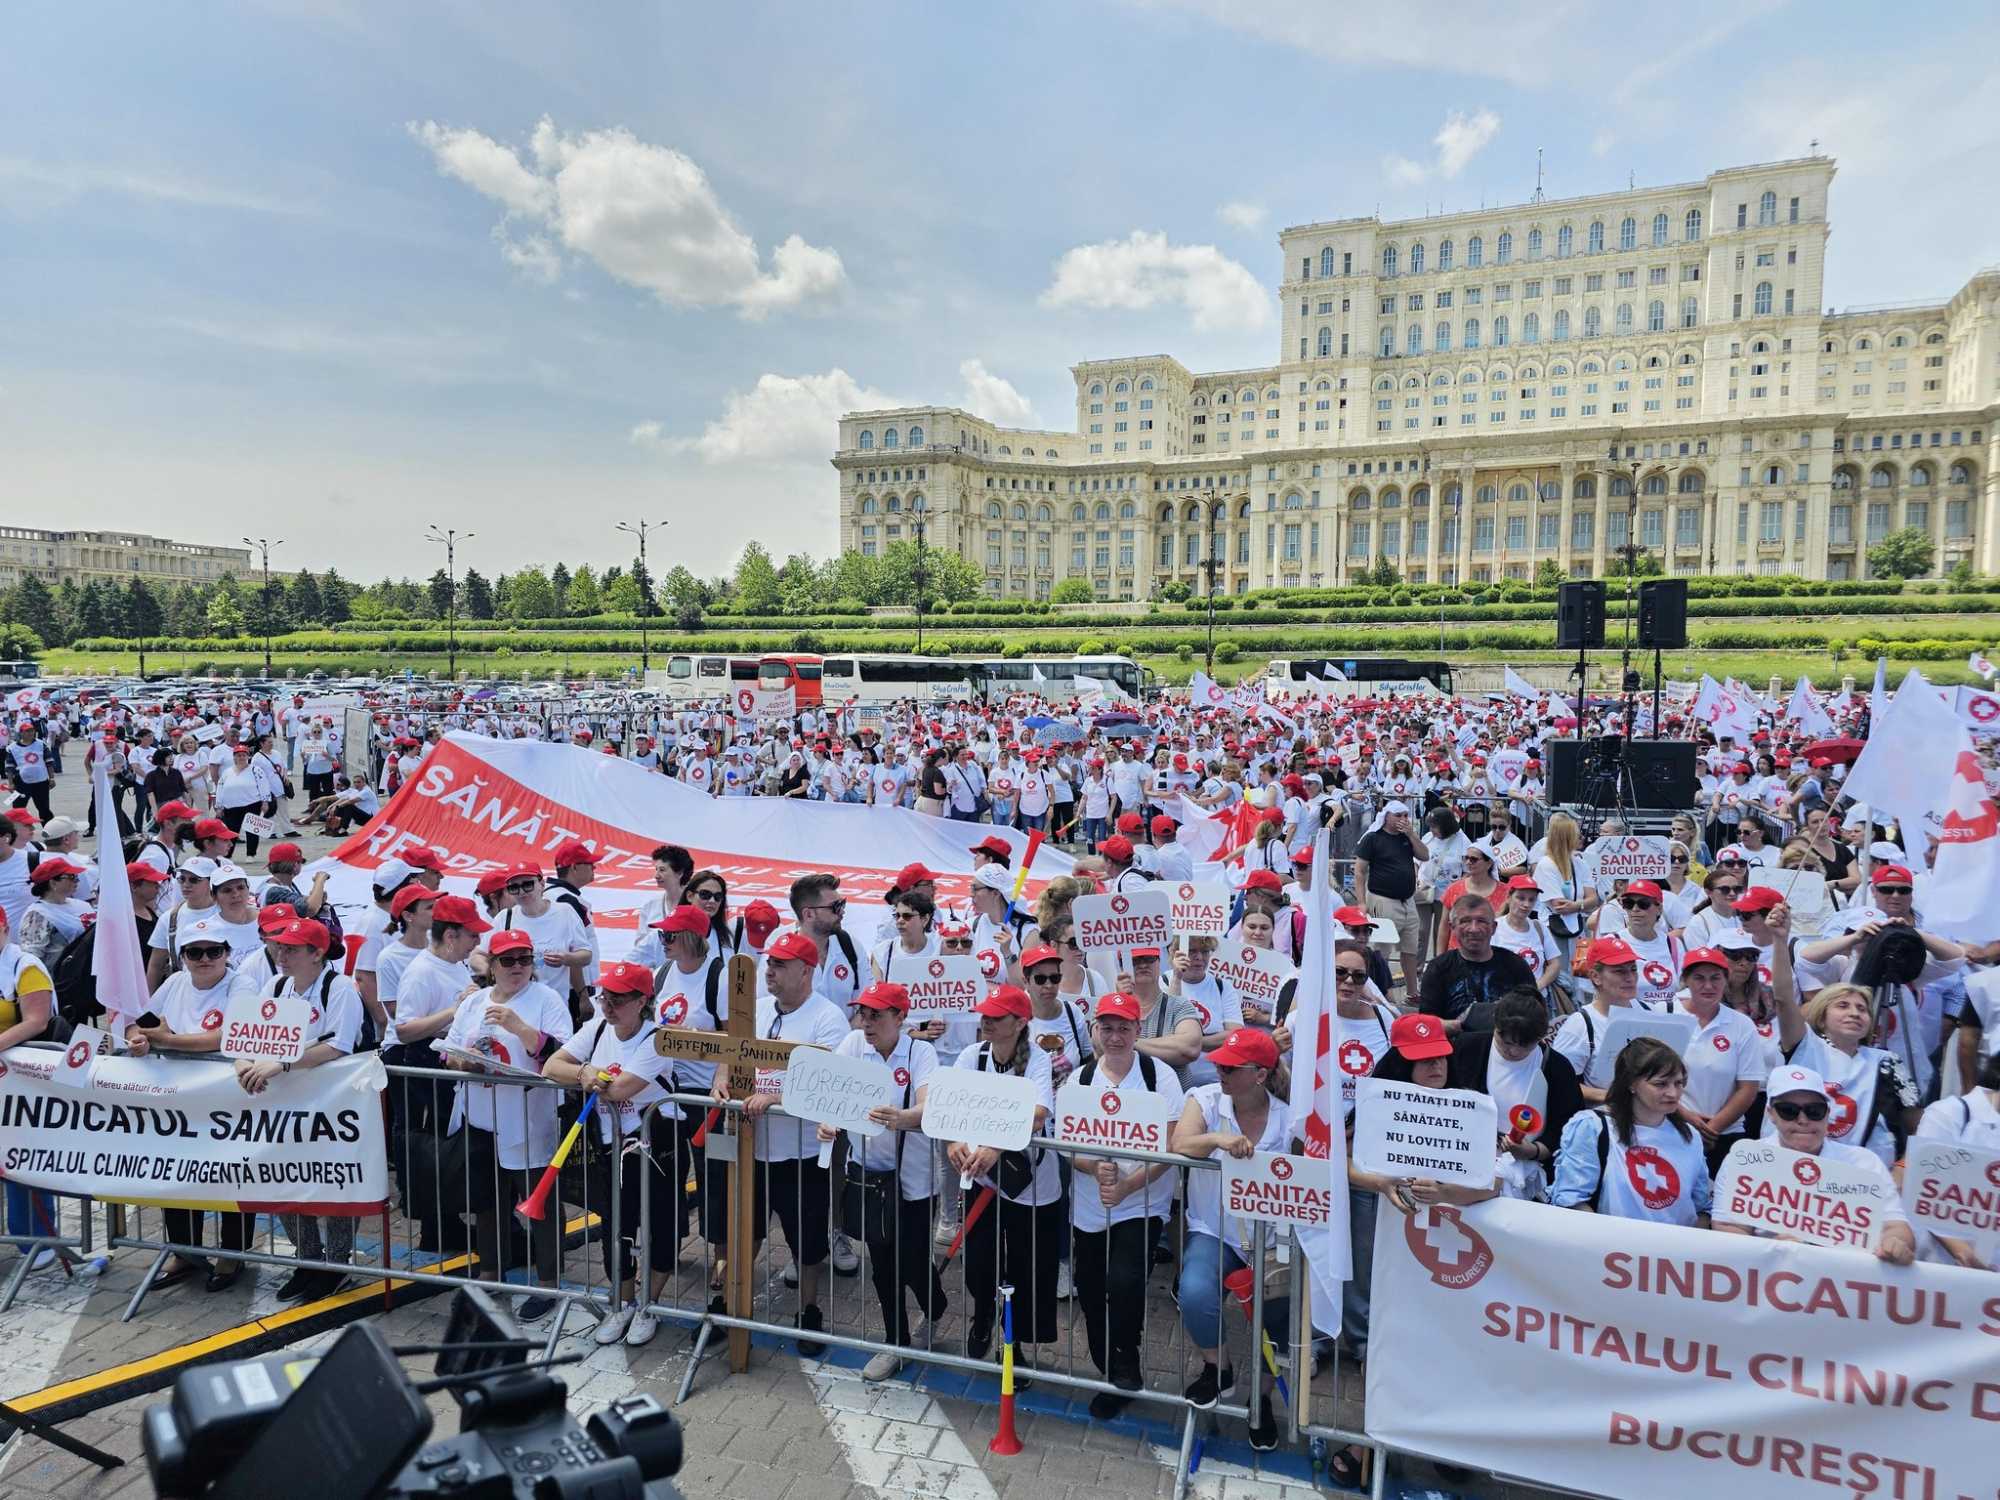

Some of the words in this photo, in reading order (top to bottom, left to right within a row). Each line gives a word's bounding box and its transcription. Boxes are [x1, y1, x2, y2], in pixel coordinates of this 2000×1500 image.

[1601, 854, 1666, 866] SANITAS
[1601, 866, 1666, 878] BUCUREȘTI
[1172, 905, 1223, 918] NITAS
[1081, 915, 1165, 935] SANITAS
[1172, 920, 1223, 934] CUREȘTI
[1082, 931, 1167, 948] BUCUREȘTI
[1209, 958, 1281, 988] SANITAS
[902, 980, 976, 997] SANITAS
[908, 996, 977, 1011] UCUREȘTI
[229, 1022, 301, 1043] SANITAS
[225, 1039, 299, 1059] BUCUREȘTI
[96, 1080, 121, 1090] Mereu
[1383, 1090, 1401, 1101] NU
[1452, 1099, 1476, 1110] DIN
[1, 1094, 199, 1138] INDICATUL
[210, 1109, 360, 1144] SANITAS
[1063, 1115, 1159, 1143] SANITAS
[1386, 1131, 1404, 1142] NU
[1408, 1134, 1452, 1150] LOVIȚI
[1456, 1138, 1470, 1151] ÎN
[5, 1147, 88, 1175] SPITALUL
[94, 1153, 150, 1180] CLINIC
[152, 1156, 172, 1181] DE
[176, 1157, 253, 1189] URGENȚĂ
[1387, 1152, 1468, 1174] DEMNITATE,
[1231, 1178, 1331, 1208] SANITAS
[1737, 1175, 1873, 1229] SANITAS
[1919, 1178, 2000, 1213] SANI
[1230, 1196, 1330, 1225] BUCUREȘT
[1731, 1196, 1869, 1249] BUCUREȘTI
[1915, 1199, 2000, 1232] BUCUR
[1440, 1252, 1489, 1284] BUCUREȘTI
[1602, 1252, 1962, 1331] SINDICATUL
[1482, 1301, 1732, 1380] SPITALUL
[1747, 1352, 1955, 1412] CLINIC
[1970, 1382, 2000, 1422] D
[1608, 1411, 1936, 1500] BUCUREȘTI
